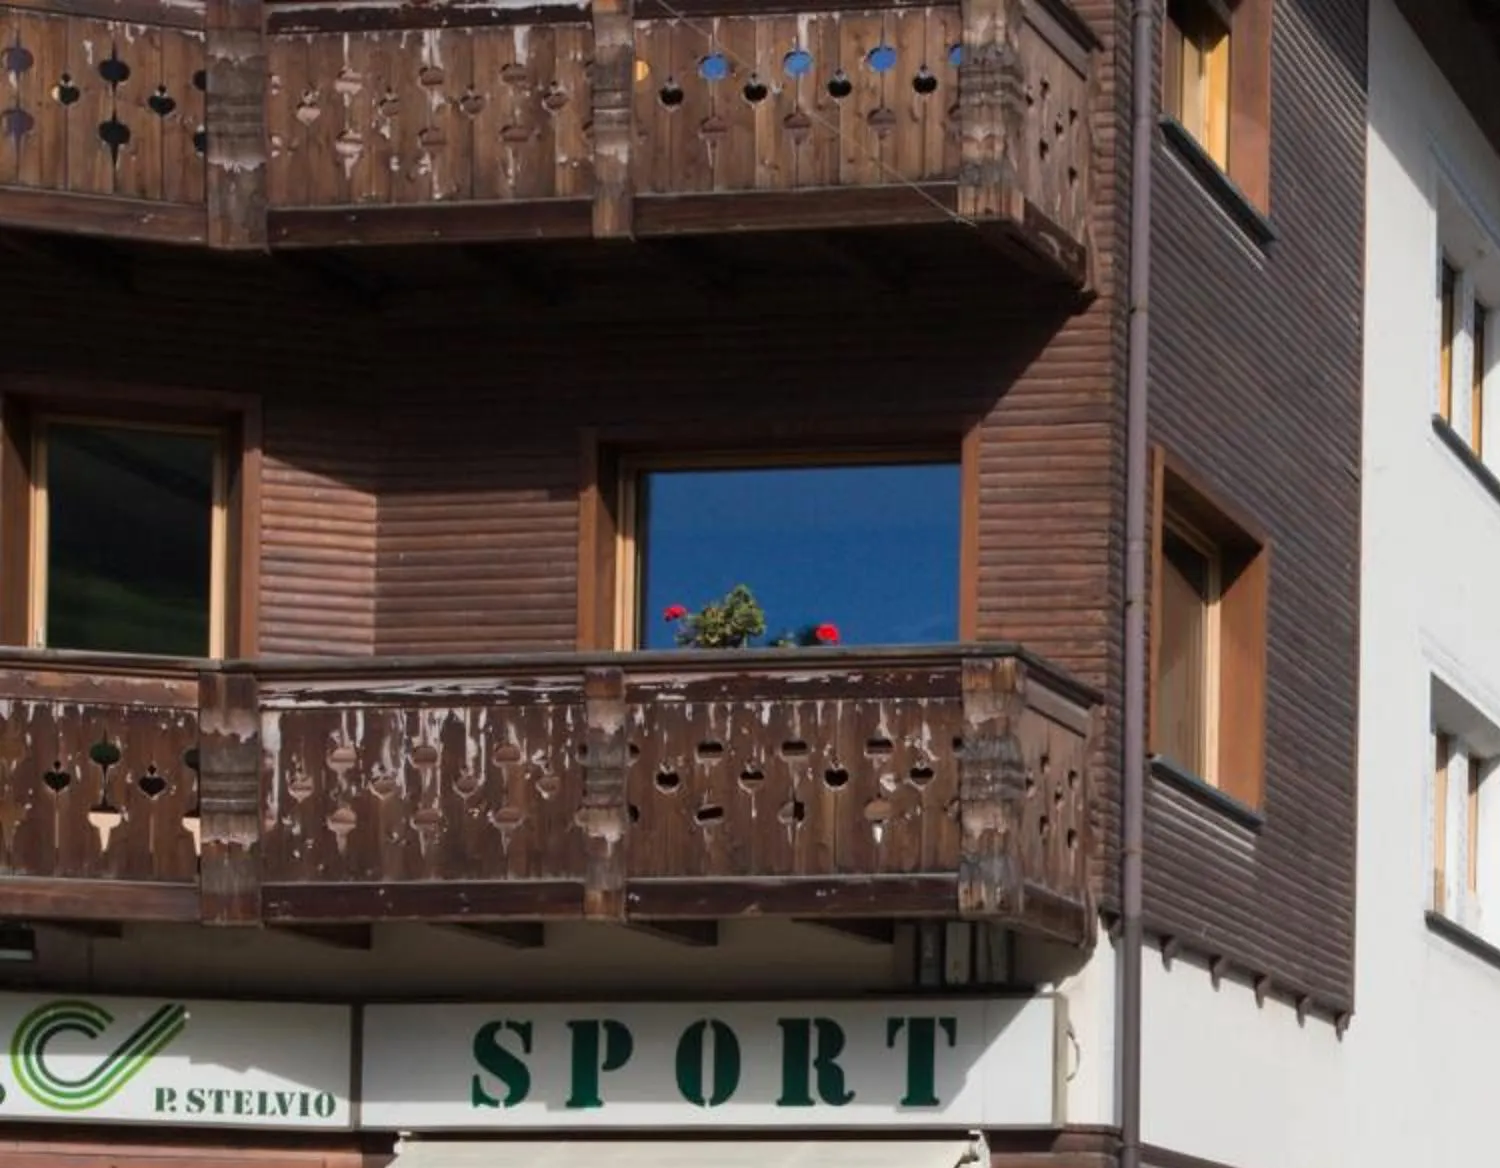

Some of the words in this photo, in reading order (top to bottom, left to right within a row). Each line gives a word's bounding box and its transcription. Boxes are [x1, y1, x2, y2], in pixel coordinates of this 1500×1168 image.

[471, 1016, 957, 1109] SPORT
[154, 1086, 177, 1113] P.
[185, 1087, 337, 1118] STELVIO
